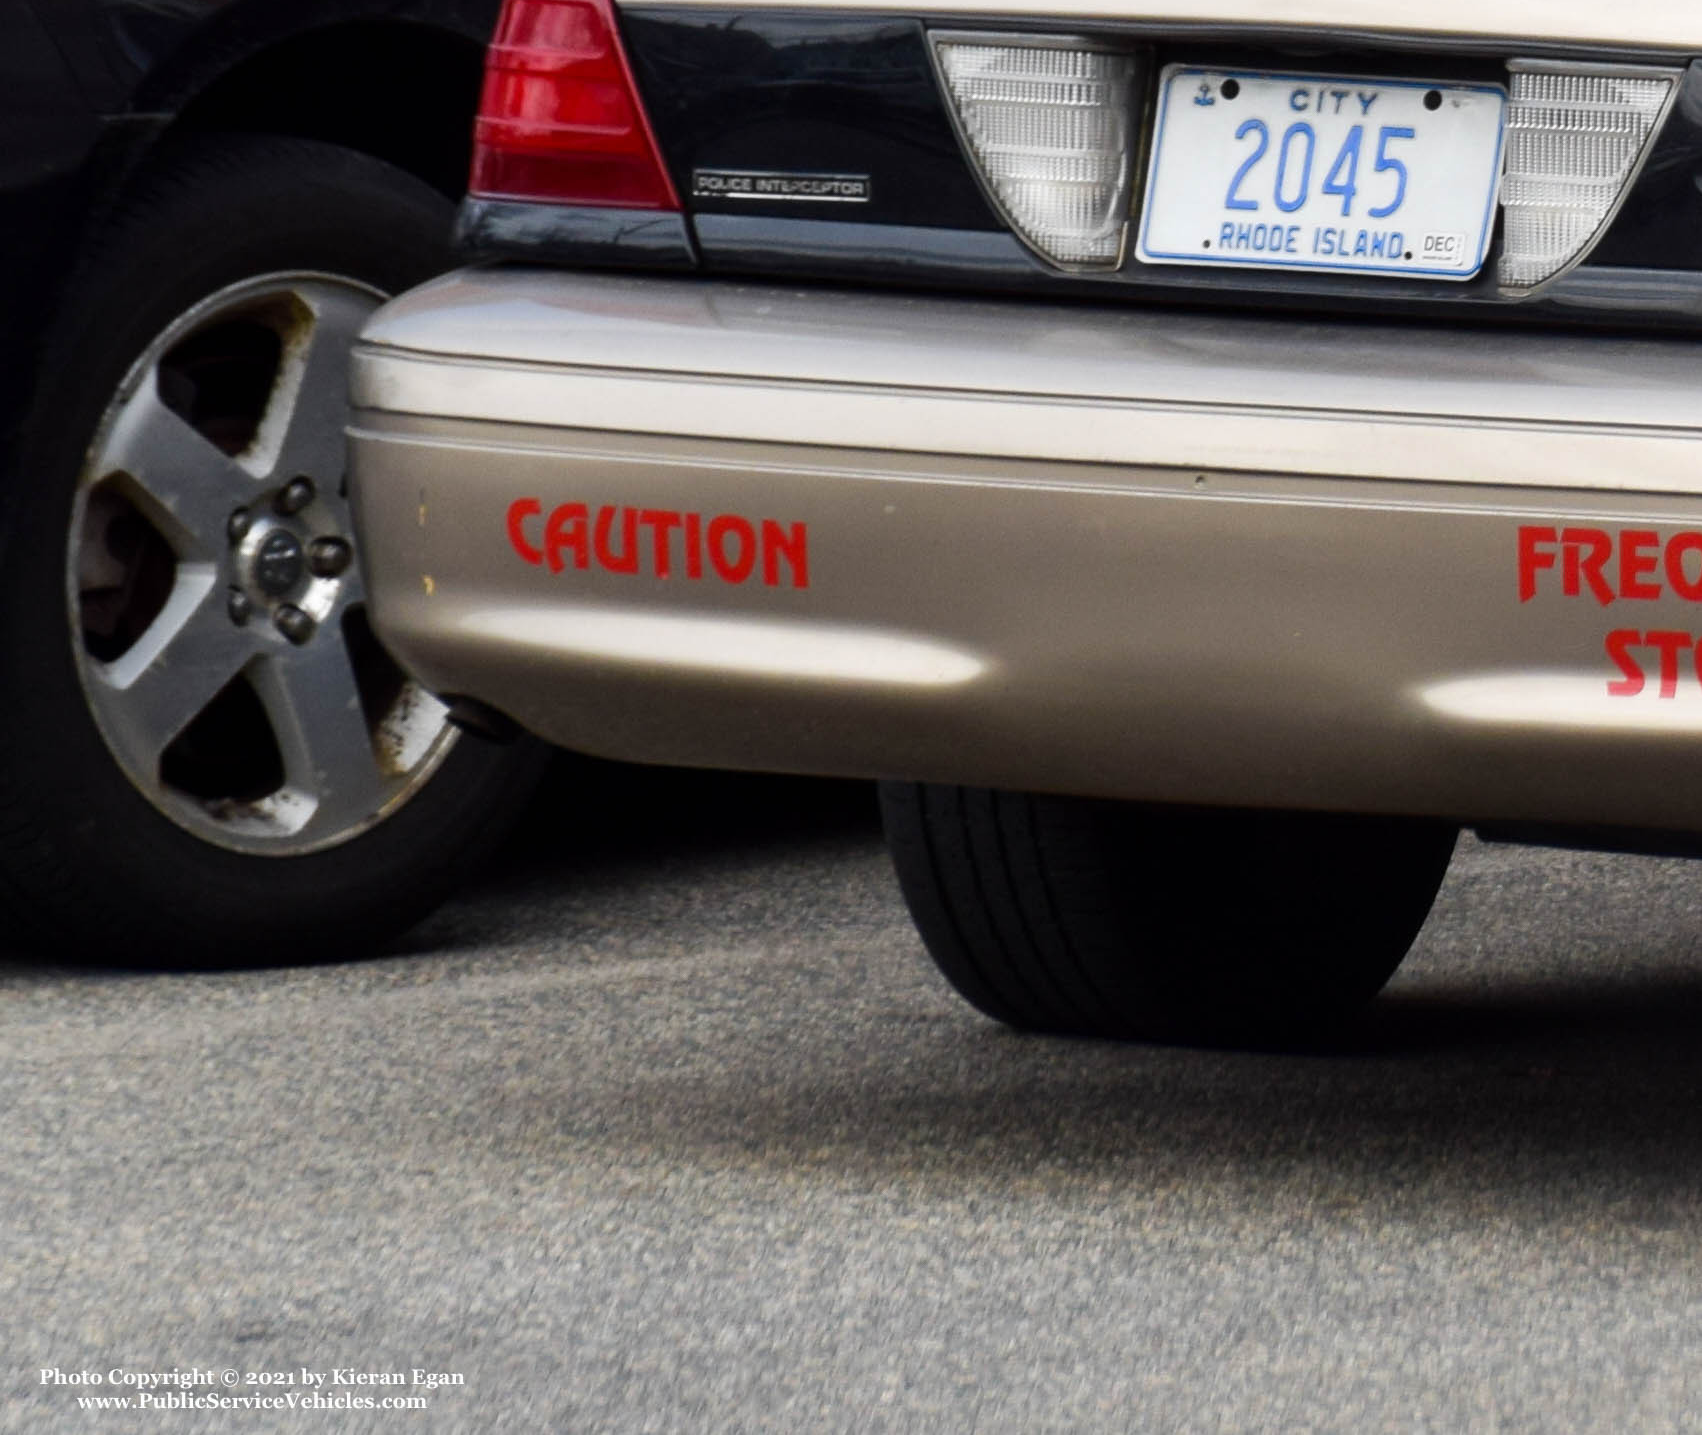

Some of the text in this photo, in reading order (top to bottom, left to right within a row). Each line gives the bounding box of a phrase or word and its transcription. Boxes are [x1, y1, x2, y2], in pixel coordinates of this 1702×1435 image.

[1288, 88, 1379, 116] CITY
[1224, 118, 1417, 219] 2045
[698, 176, 866, 195] POLICE INTERCEPTOR
[1219, 221, 1406, 260] RHODE ISLAND
[1423, 235, 1456, 253] DEC
[505, 496, 810, 591] CAUTION
